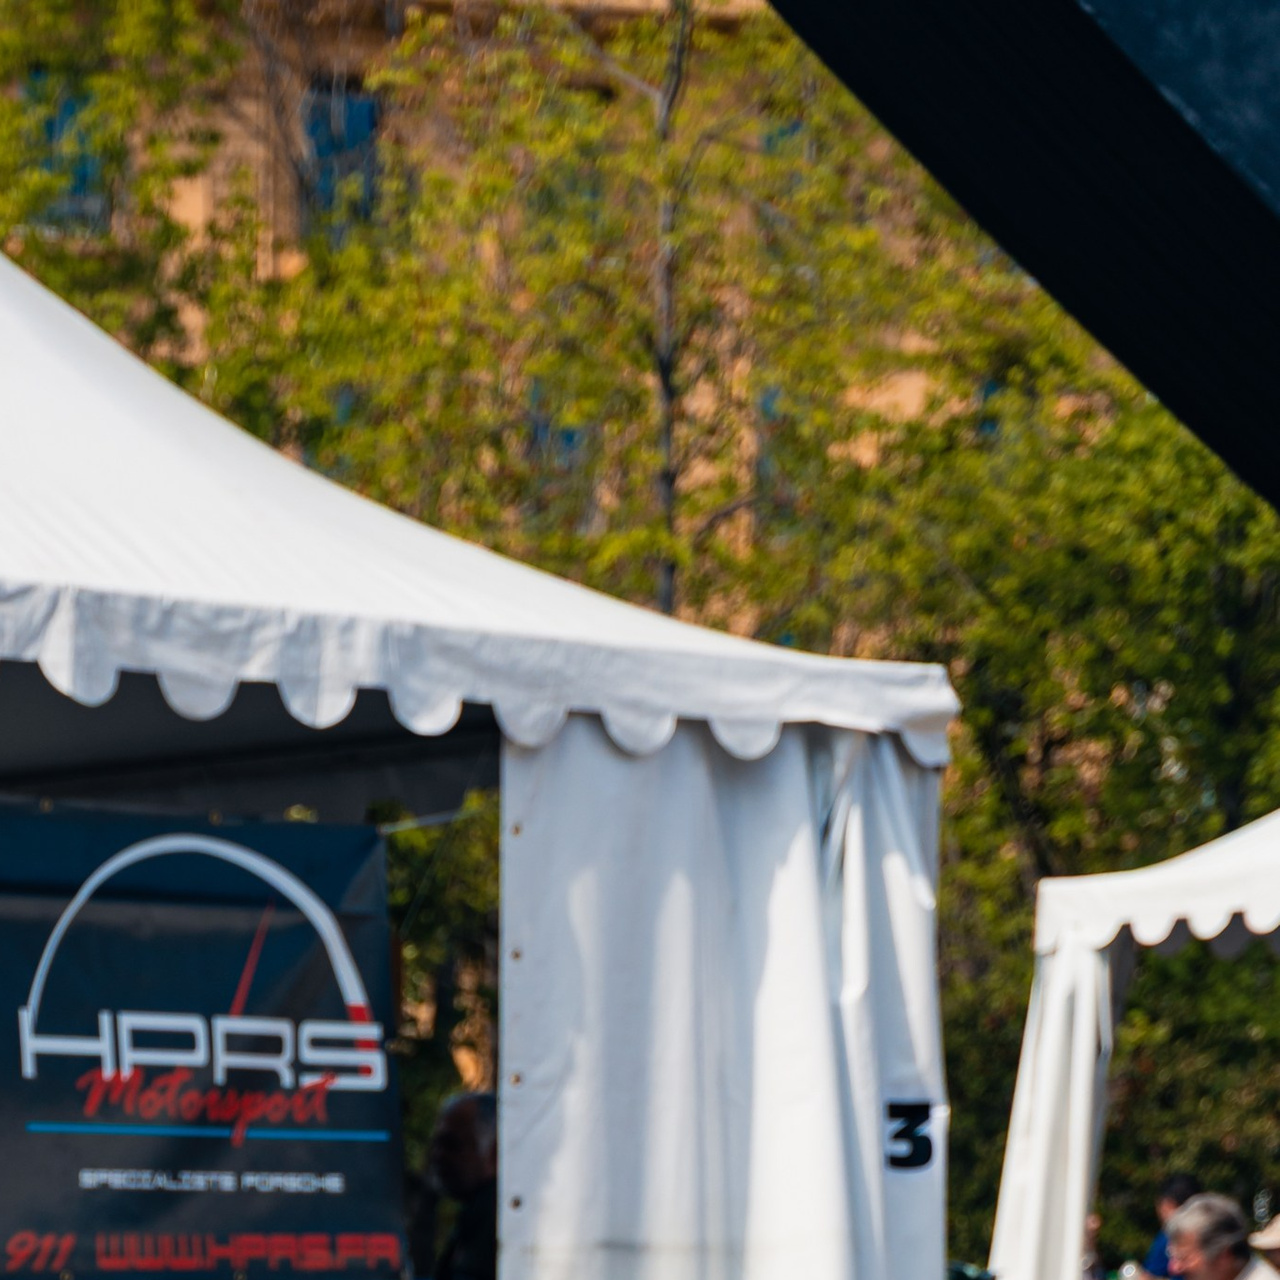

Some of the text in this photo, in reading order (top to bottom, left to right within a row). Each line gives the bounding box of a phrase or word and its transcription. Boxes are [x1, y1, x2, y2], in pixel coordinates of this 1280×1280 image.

[18, 1005, 388, 1092] HPRS
[75, 1065, 339, 1147] Motorsport
[885, 1102, 934, 1169] 3
[240, 1171, 345, 1194] PORSCHE
